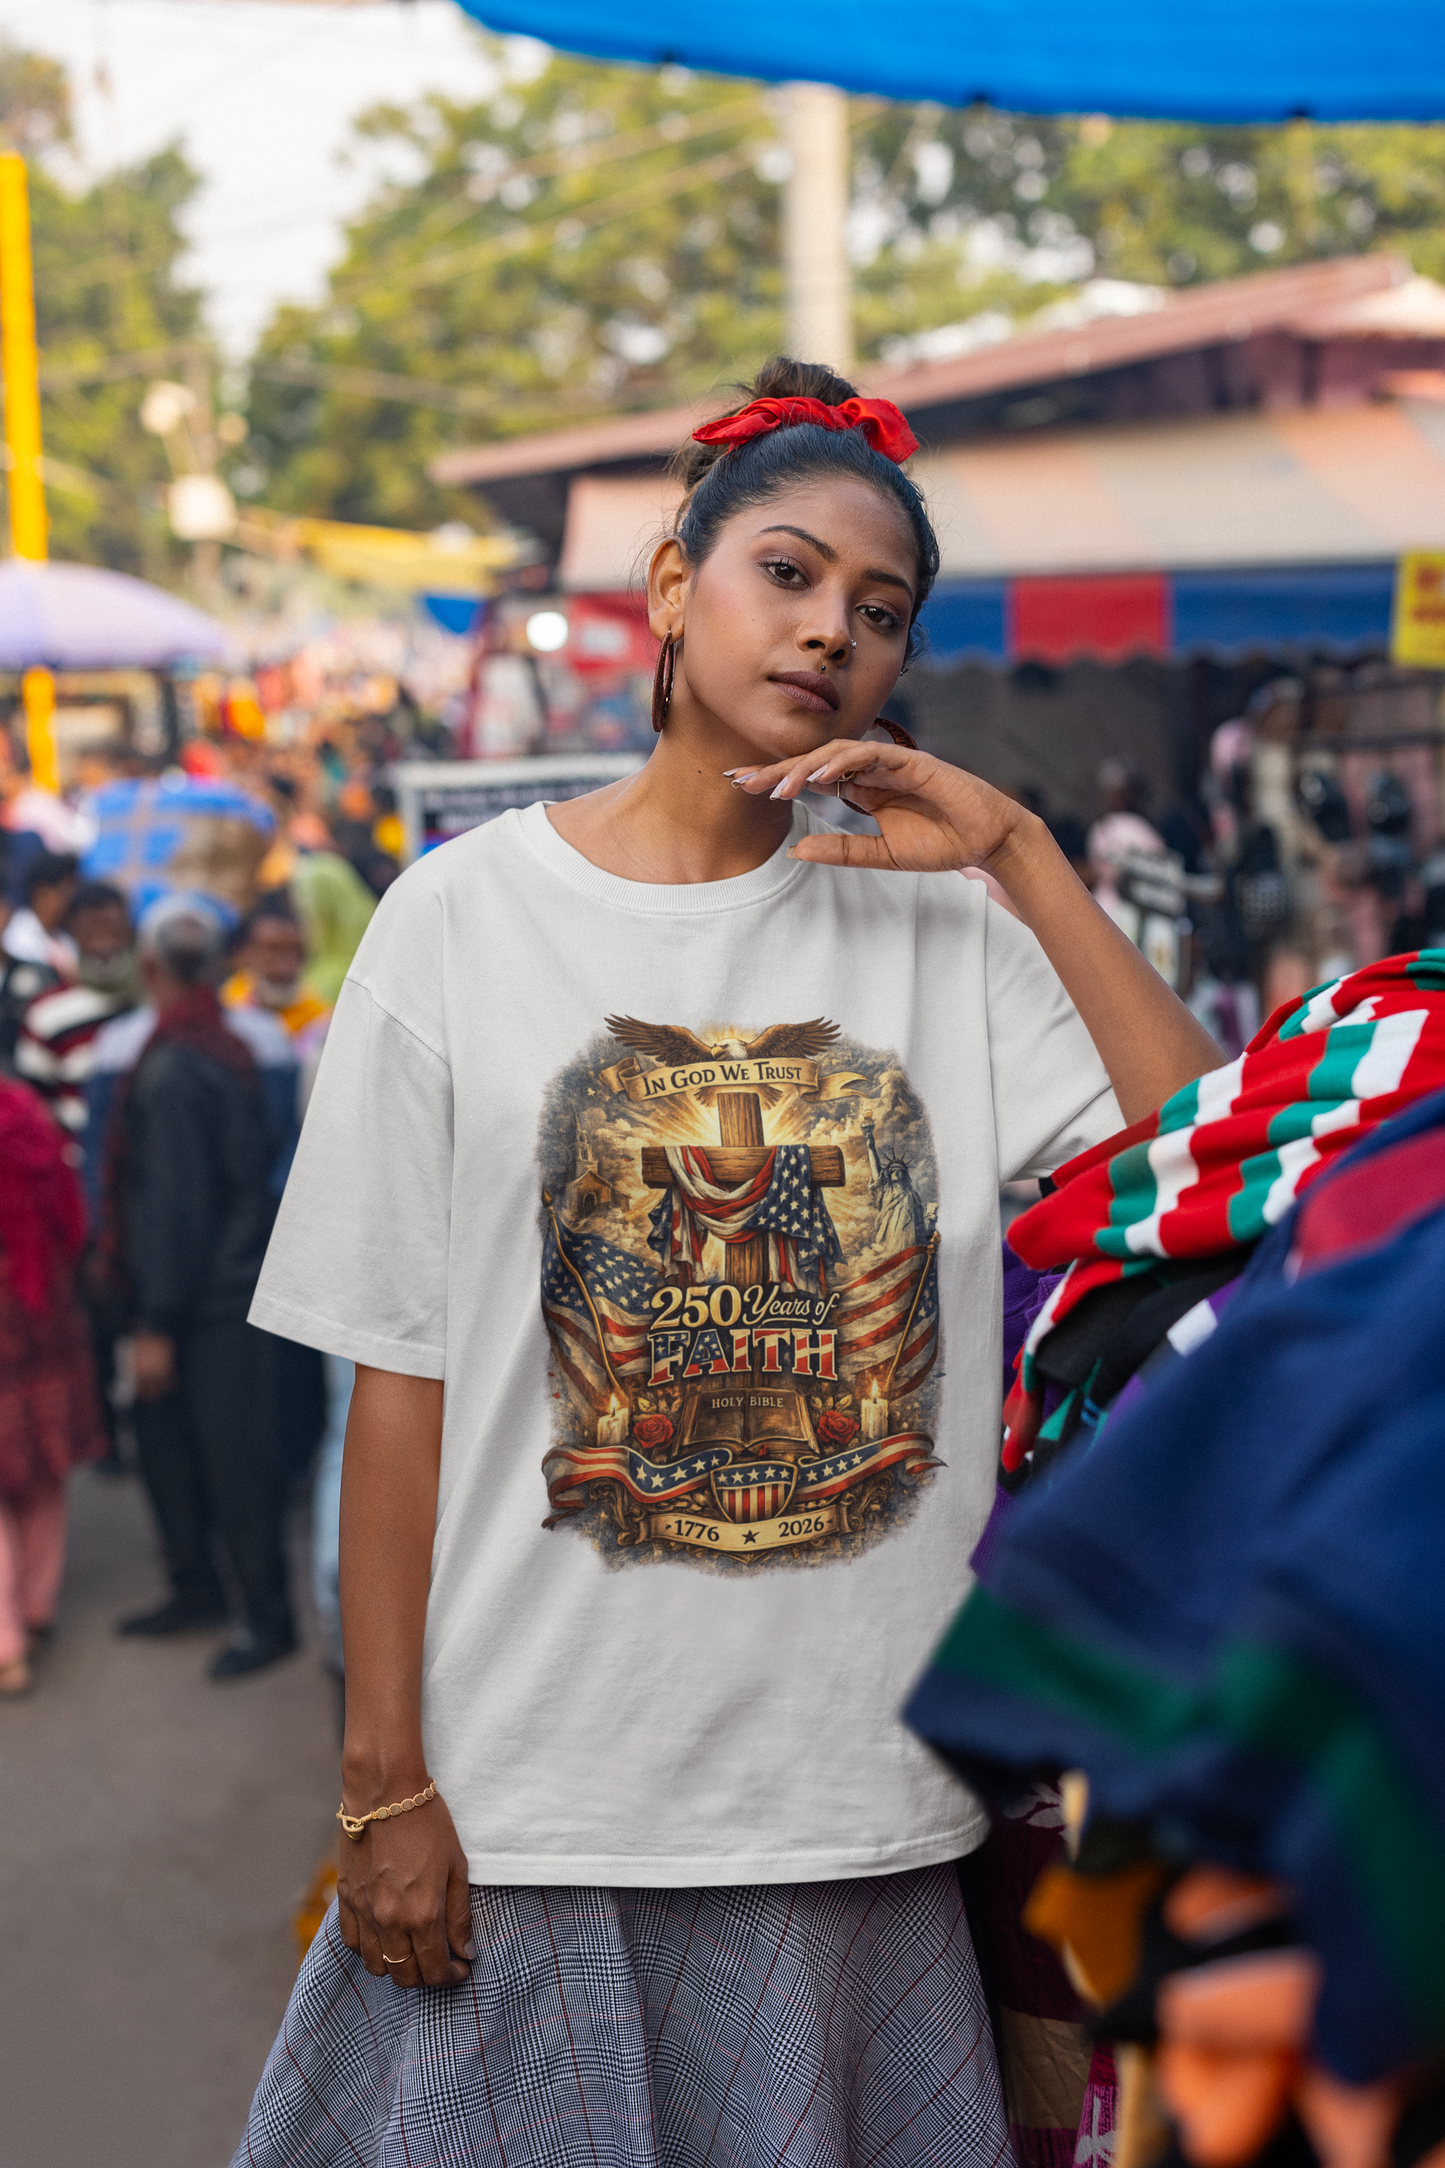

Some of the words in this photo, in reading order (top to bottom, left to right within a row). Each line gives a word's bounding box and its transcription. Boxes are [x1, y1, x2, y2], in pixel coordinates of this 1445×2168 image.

[650, 1285, 742, 1330] 250
[742, 1284, 811, 1325] Years
[812, 1293, 840, 1325] of
[647, 1328, 838, 1386] FAITH
[712, 1396, 744, 1409] HOLY
[750, 1396, 784, 1408] BIBLE
[674, 1519, 720, 1542] 1776
[778, 1515, 825, 1538] 2026
